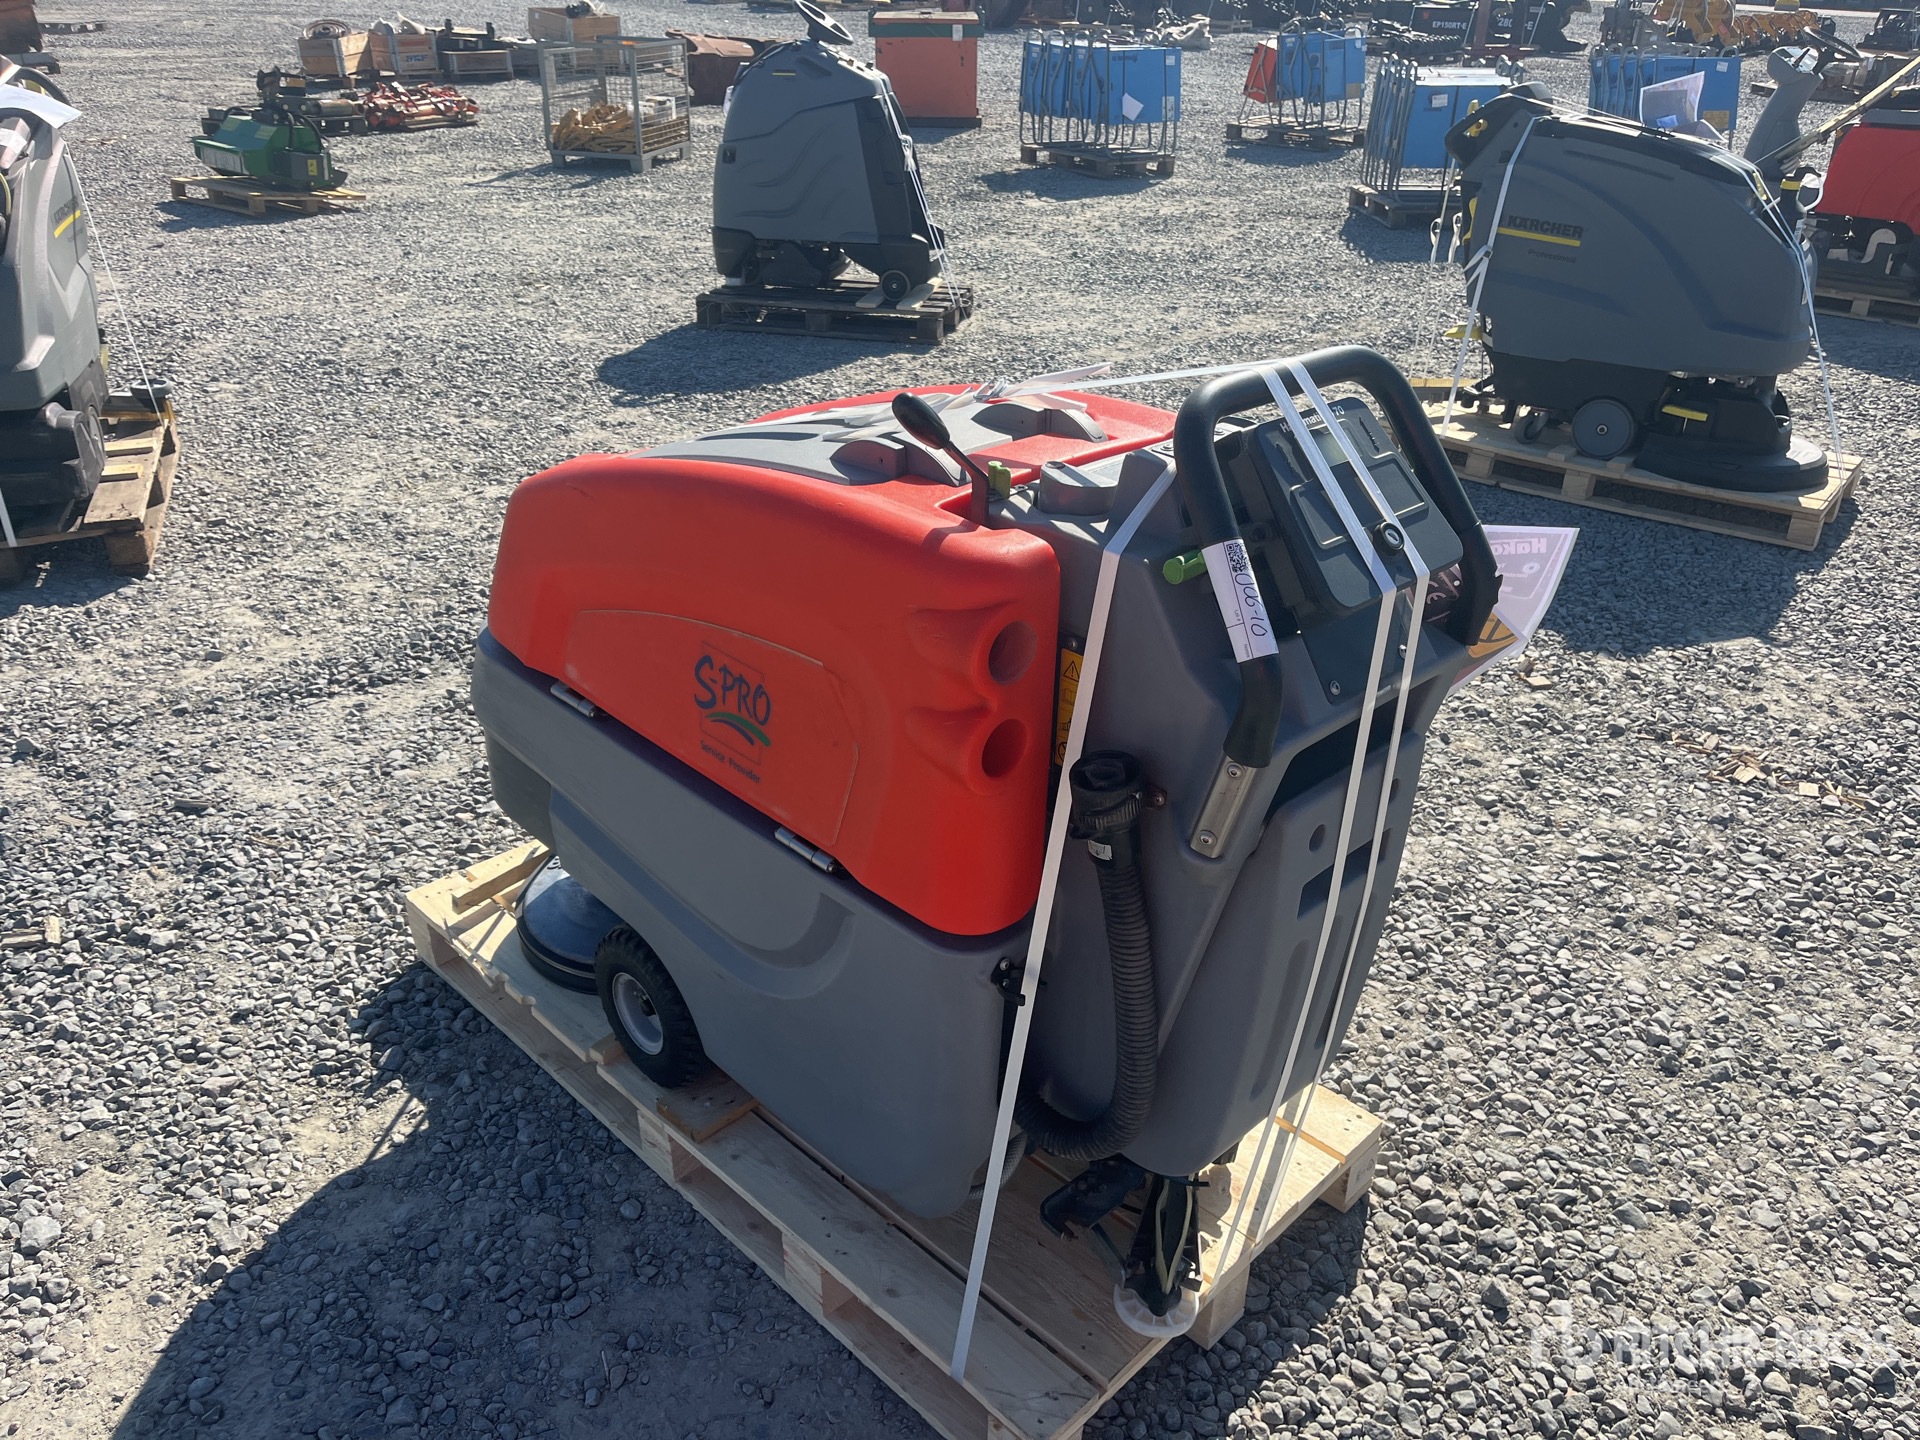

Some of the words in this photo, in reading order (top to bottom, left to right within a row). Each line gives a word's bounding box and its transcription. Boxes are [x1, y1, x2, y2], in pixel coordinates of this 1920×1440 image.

[694, 656, 771, 726] S-PRO
[700, 739, 726, 763] Service
[729, 757, 761, 784] Provider
